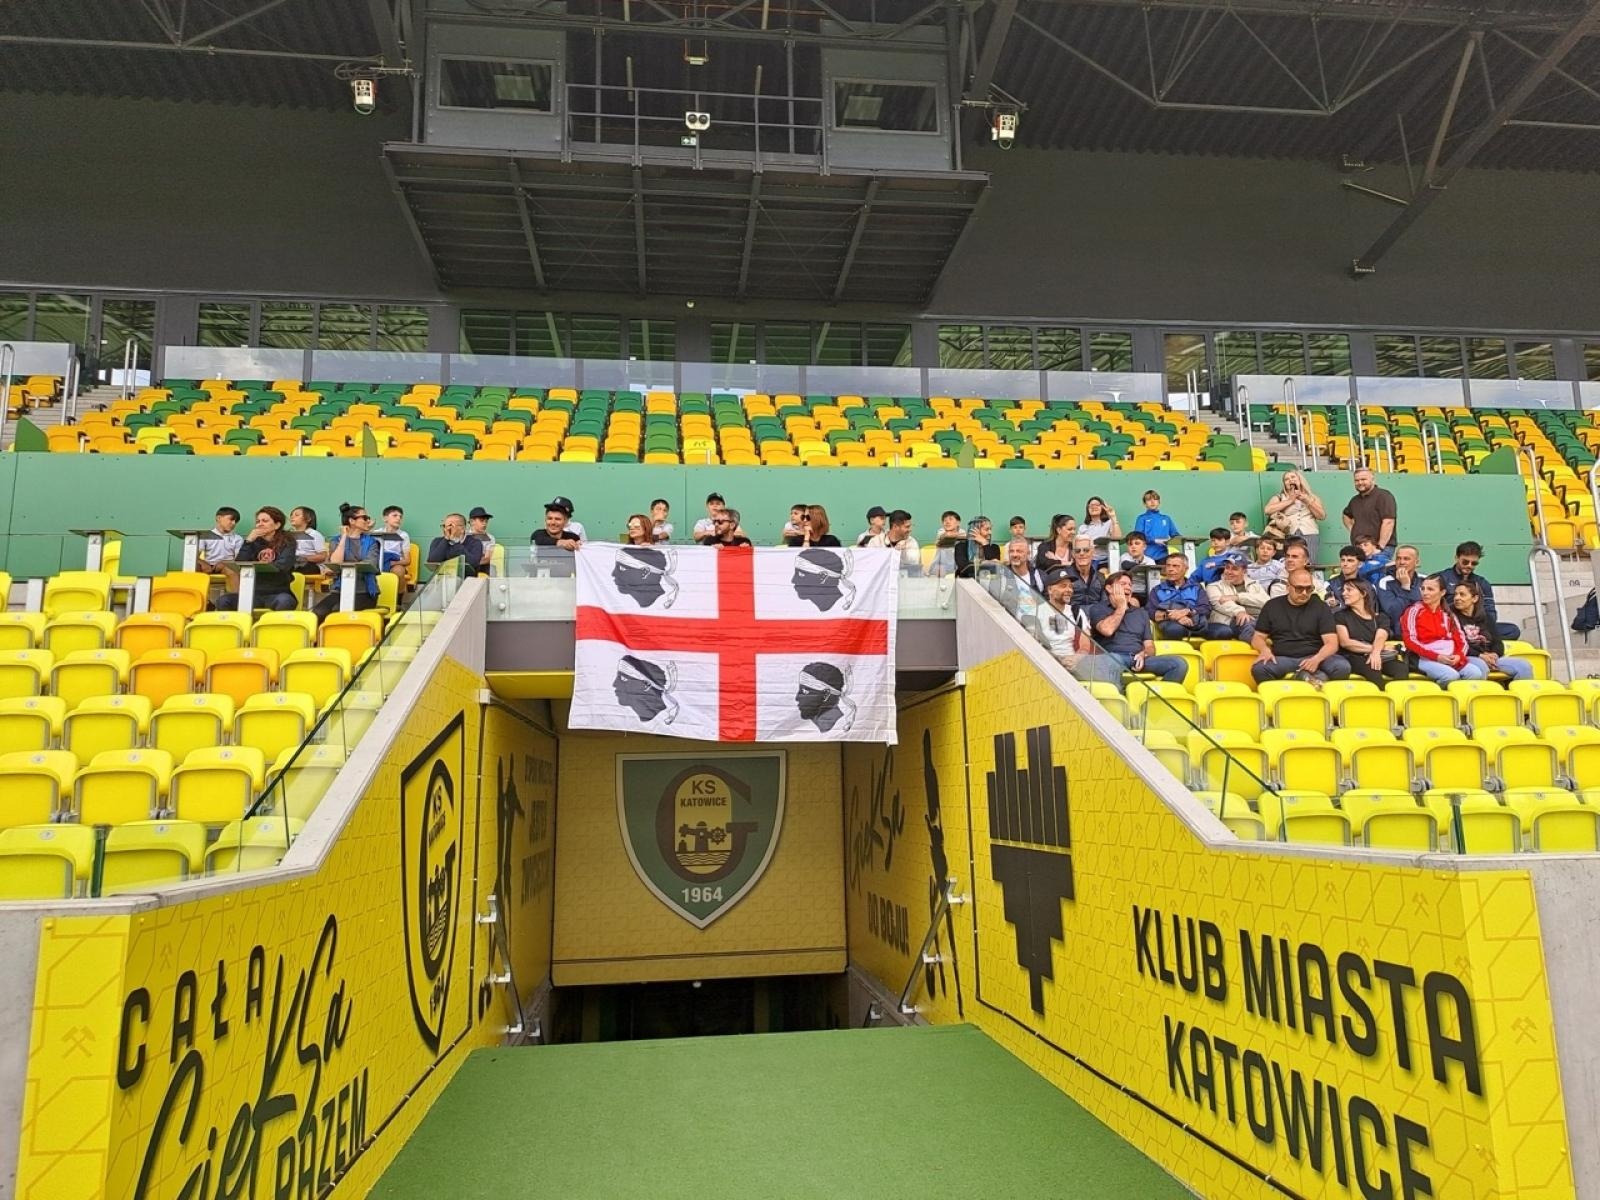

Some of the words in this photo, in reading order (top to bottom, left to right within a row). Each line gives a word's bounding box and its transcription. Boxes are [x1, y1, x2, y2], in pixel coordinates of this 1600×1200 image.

[680, 797, 727, 808] KATOWICE
[692, 780, 716, 795] KS
[682, 887, 722, 903] 1964
[117, 944, 266, 1090] CAŁA
[1132, 904, 1228, 1001] KLUB
[1239, 929, 1483, 1097] MIASTA
[1163, 1014, 1433, 1200] KATOWICE
